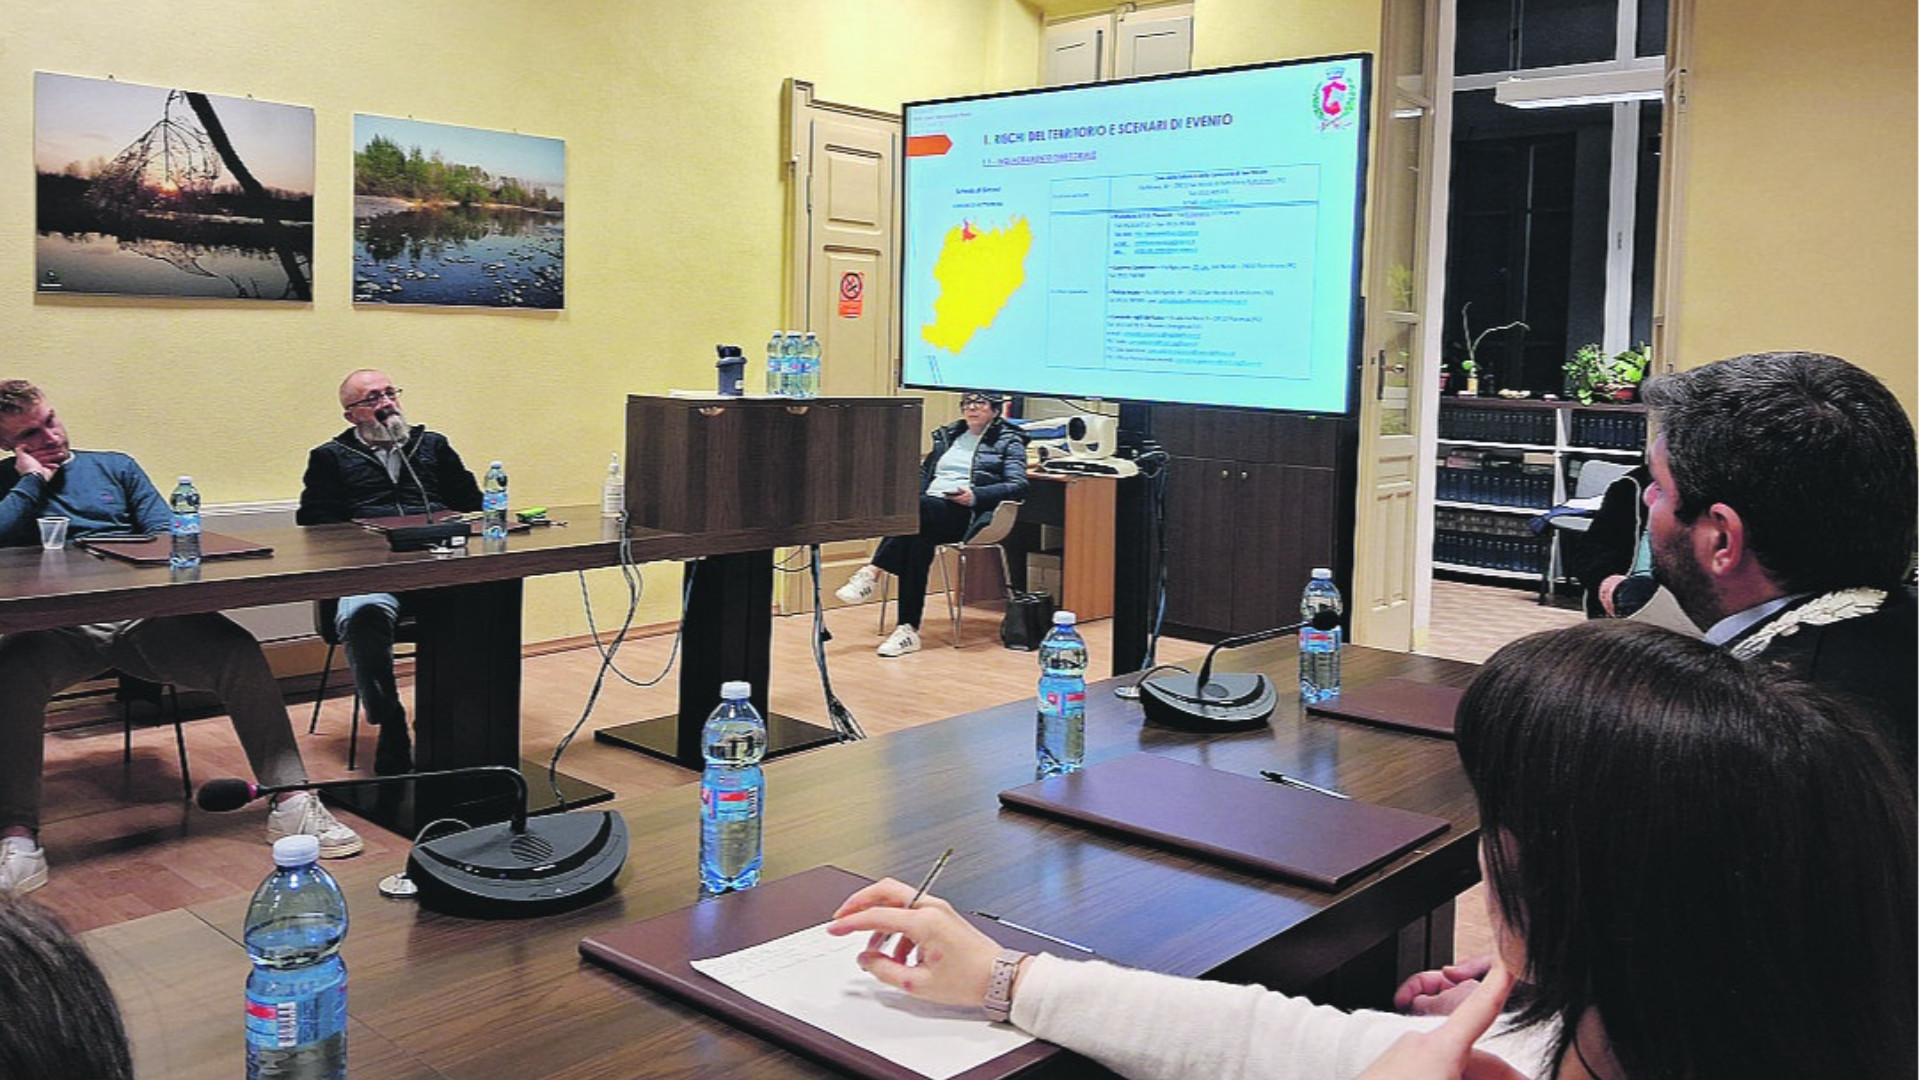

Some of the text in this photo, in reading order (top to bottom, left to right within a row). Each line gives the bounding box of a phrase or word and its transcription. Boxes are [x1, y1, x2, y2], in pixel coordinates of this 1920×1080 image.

[1028, 130, 1046, 142] DEL
[1047, 125, 1107, 140] TERRITORIO
[1109, 123, 1116, 136] E
[1118, 119, 1168, 135] SCENARI
[1170, 118, 1183, 130] DI
[1186, 113, 1234, 129] EVENTO
